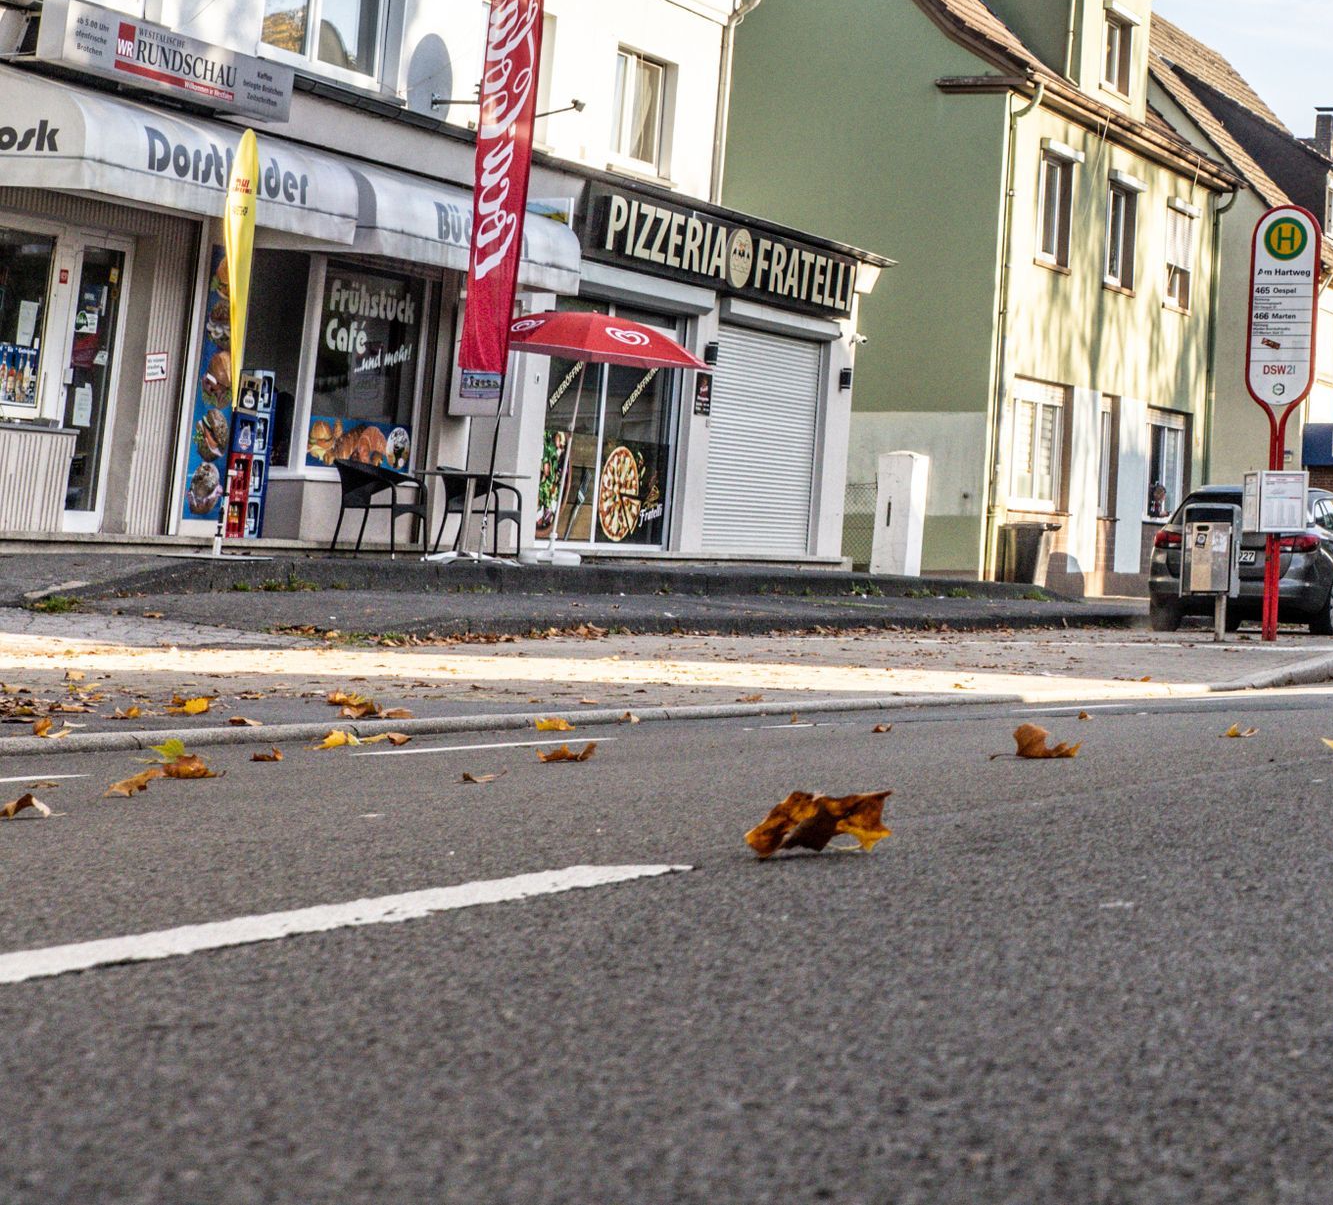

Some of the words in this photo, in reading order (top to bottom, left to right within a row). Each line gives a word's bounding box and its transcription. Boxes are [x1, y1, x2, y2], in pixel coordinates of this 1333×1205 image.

[117, 38, 134, 58] WR
[136, 40, 237, 88] RUNDSCHAU
[605, 195, 728, 280] PIZZERIA
[754, 237, 856, 313] FRATELLI
[1257, 268, 1272, 276] Am
[1275, 268, 1311, 278] Hartweg
[329, 279, 415, 325] Frühstück
[1255, 286, 1270, 294] 465
[1273, 287, 1297, 295] Oespel
[1254, 312, 1269, 320] 466
[326, 318, 368, 355] Café
